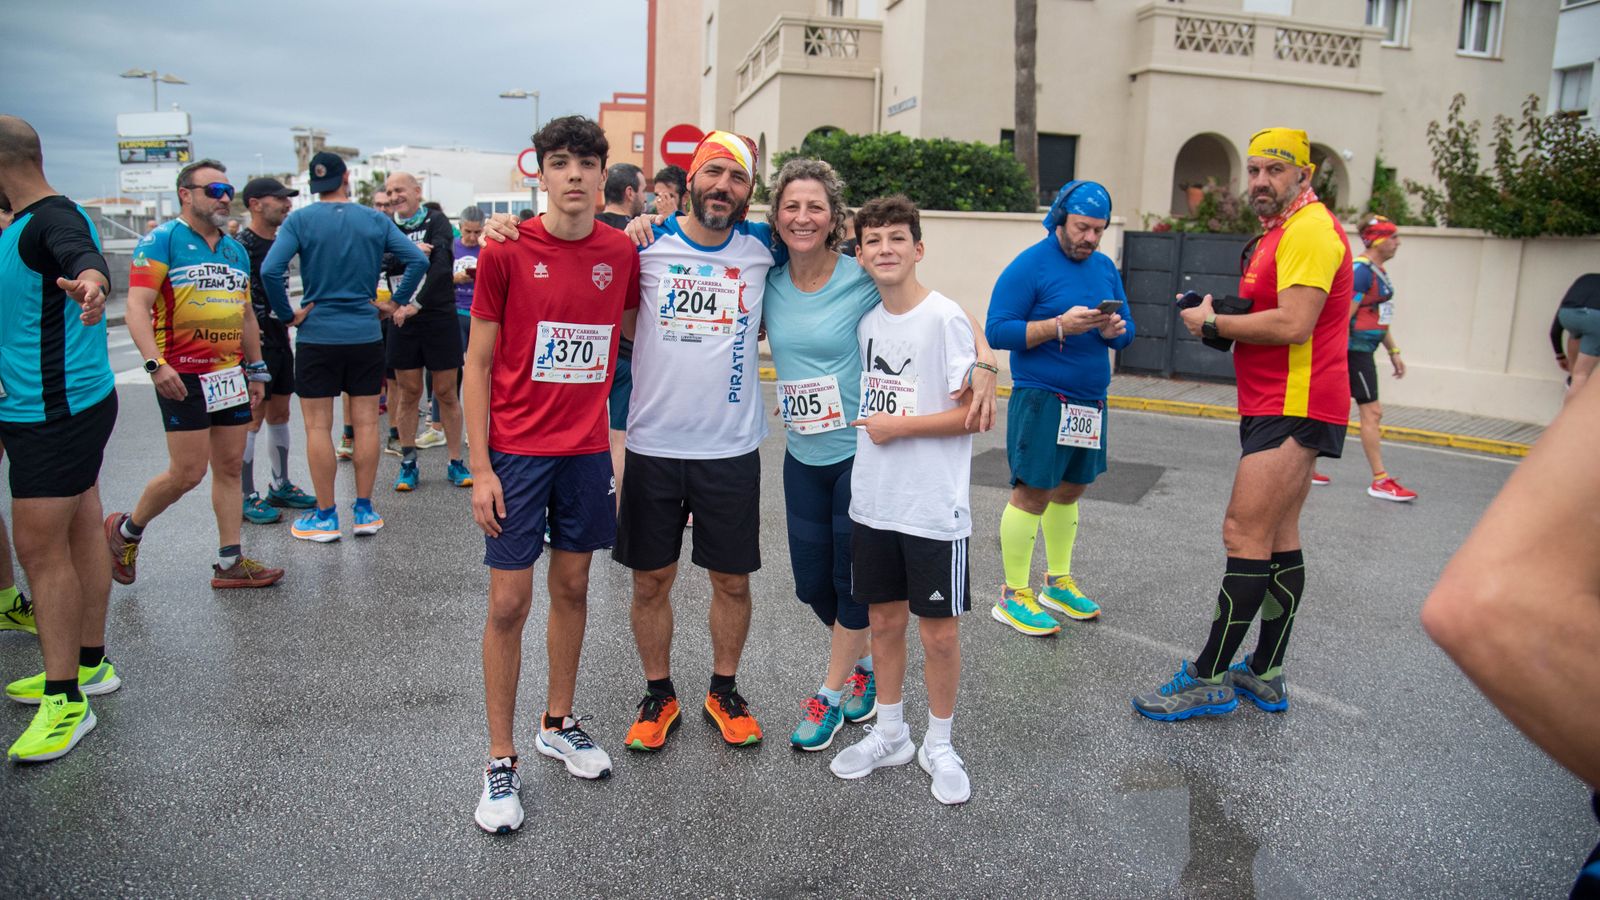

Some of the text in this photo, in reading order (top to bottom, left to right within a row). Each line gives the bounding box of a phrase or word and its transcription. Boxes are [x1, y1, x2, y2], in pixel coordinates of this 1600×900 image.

[204, 265, 230, 275] TRAIL
[199, 278, 225, 289] TEAM
[672, 278, 697, 290] XIV
[676, 290, 717, 315] 204
[551, 327, 576, 339] XIV
[555, 339, 593, 363] 370
[209, 373, 222, 383] XIV
[869, 376, 881, 388] XIV
[215, 378, 236, 396] 171
[784, 384, 797, 395] XIV
[808, 385, 835, 393] ESTRECHO
[889, 385, 915, 393] ESTRECHO
[789, 393, 822, 417] 205
[868, 389, 897, 415] 206
[1070, 407, 1082, 416] XIV
[1071, 416, 1092, 433] 308
